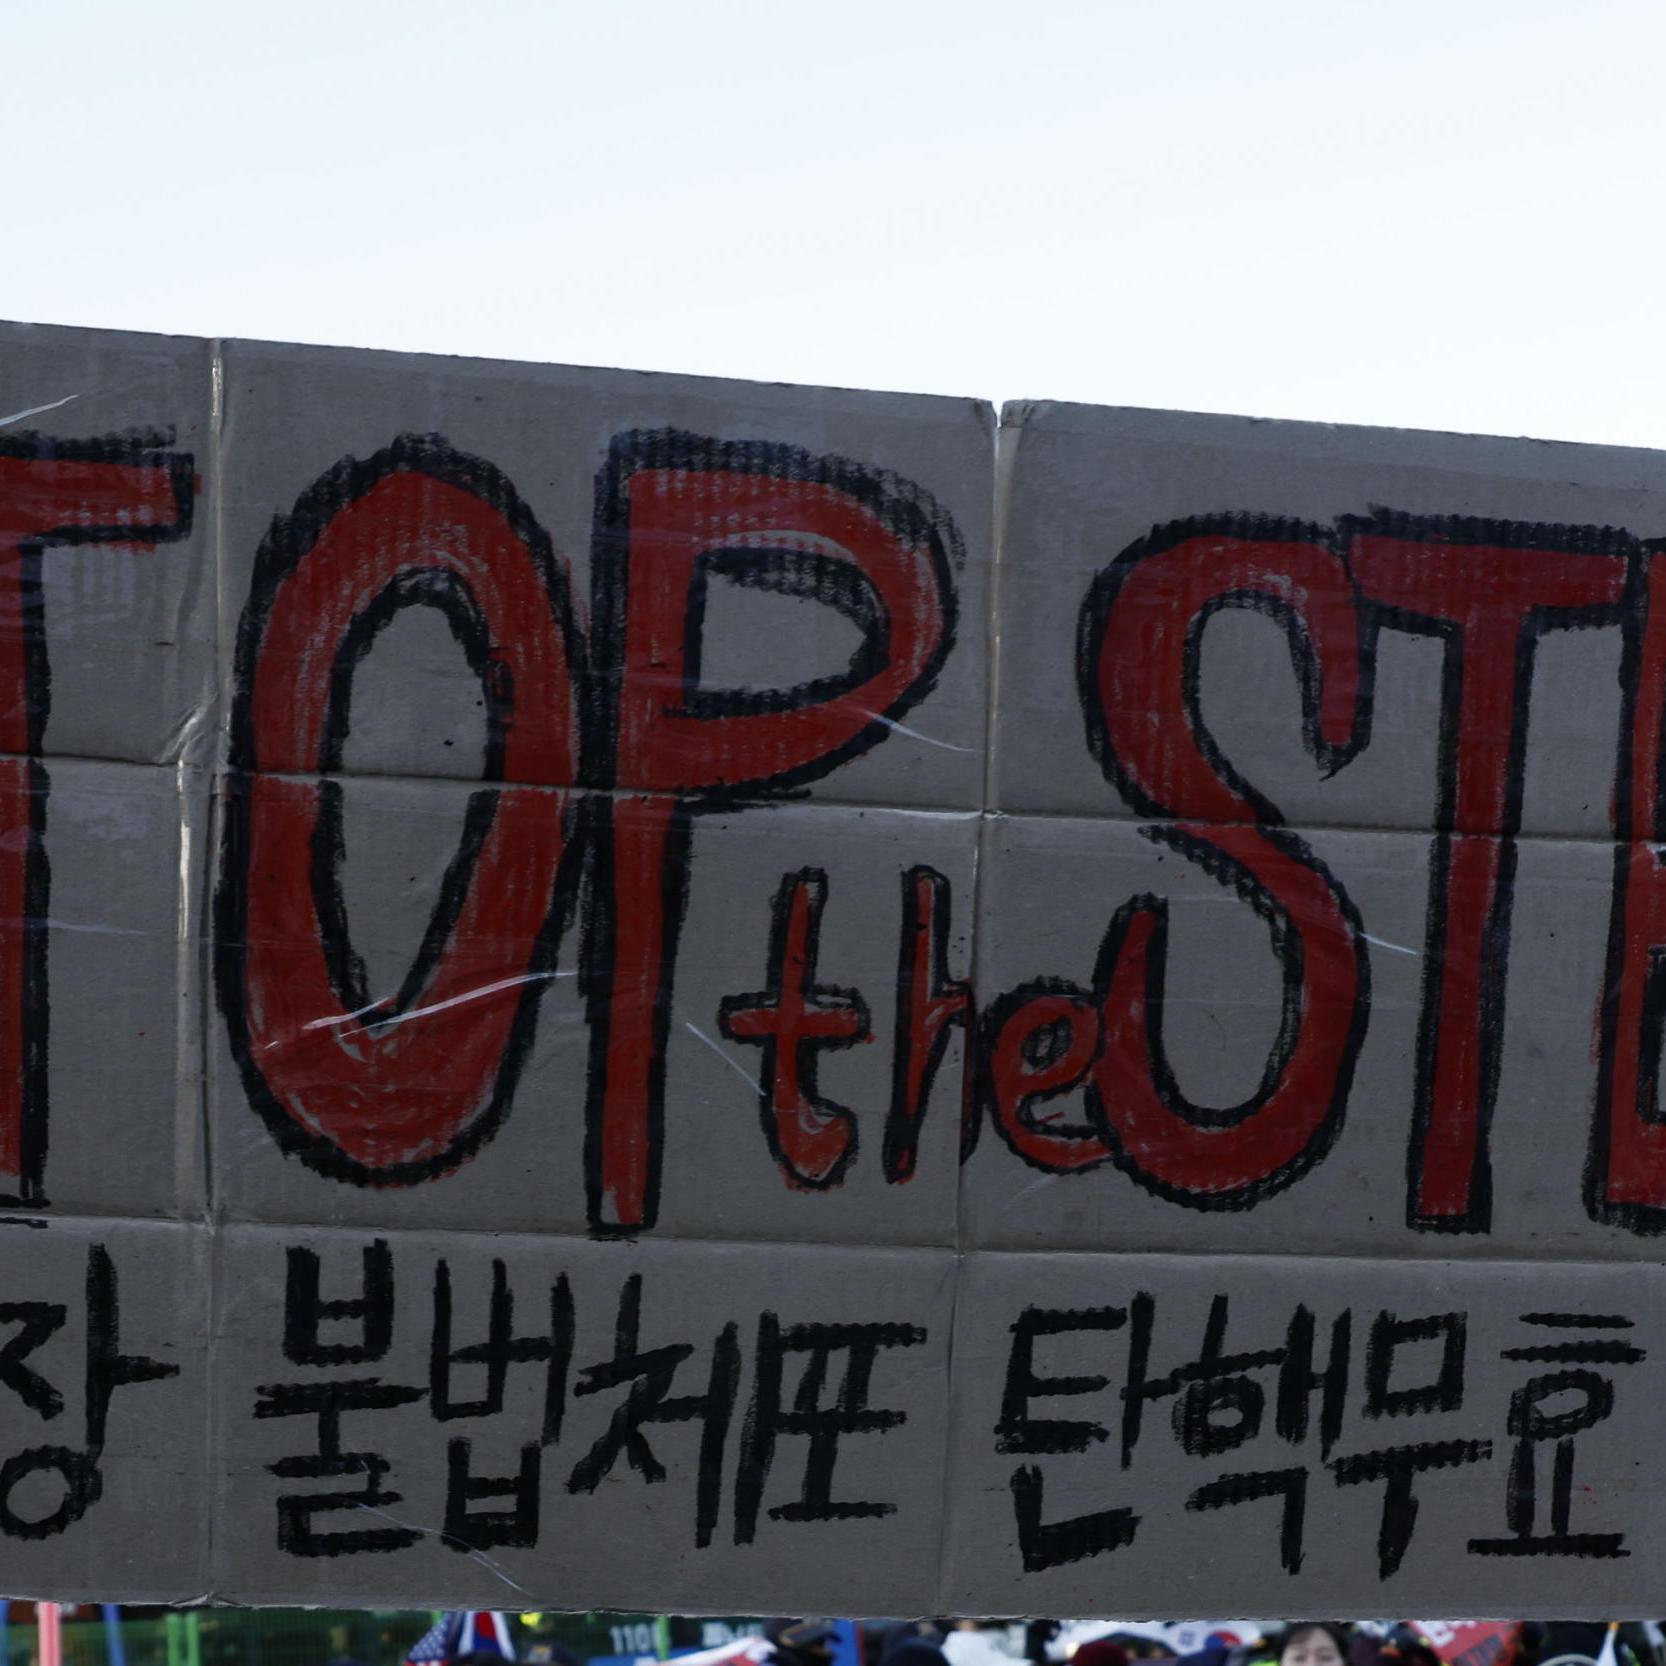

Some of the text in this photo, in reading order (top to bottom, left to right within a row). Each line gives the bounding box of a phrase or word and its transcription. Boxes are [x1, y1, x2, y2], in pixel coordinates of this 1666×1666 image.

[716, 862, 1117, 1193] the
[253, 1237, 928, 1558] 불법체포
[994, 1290, 1647, 1582] 탄핵무효
